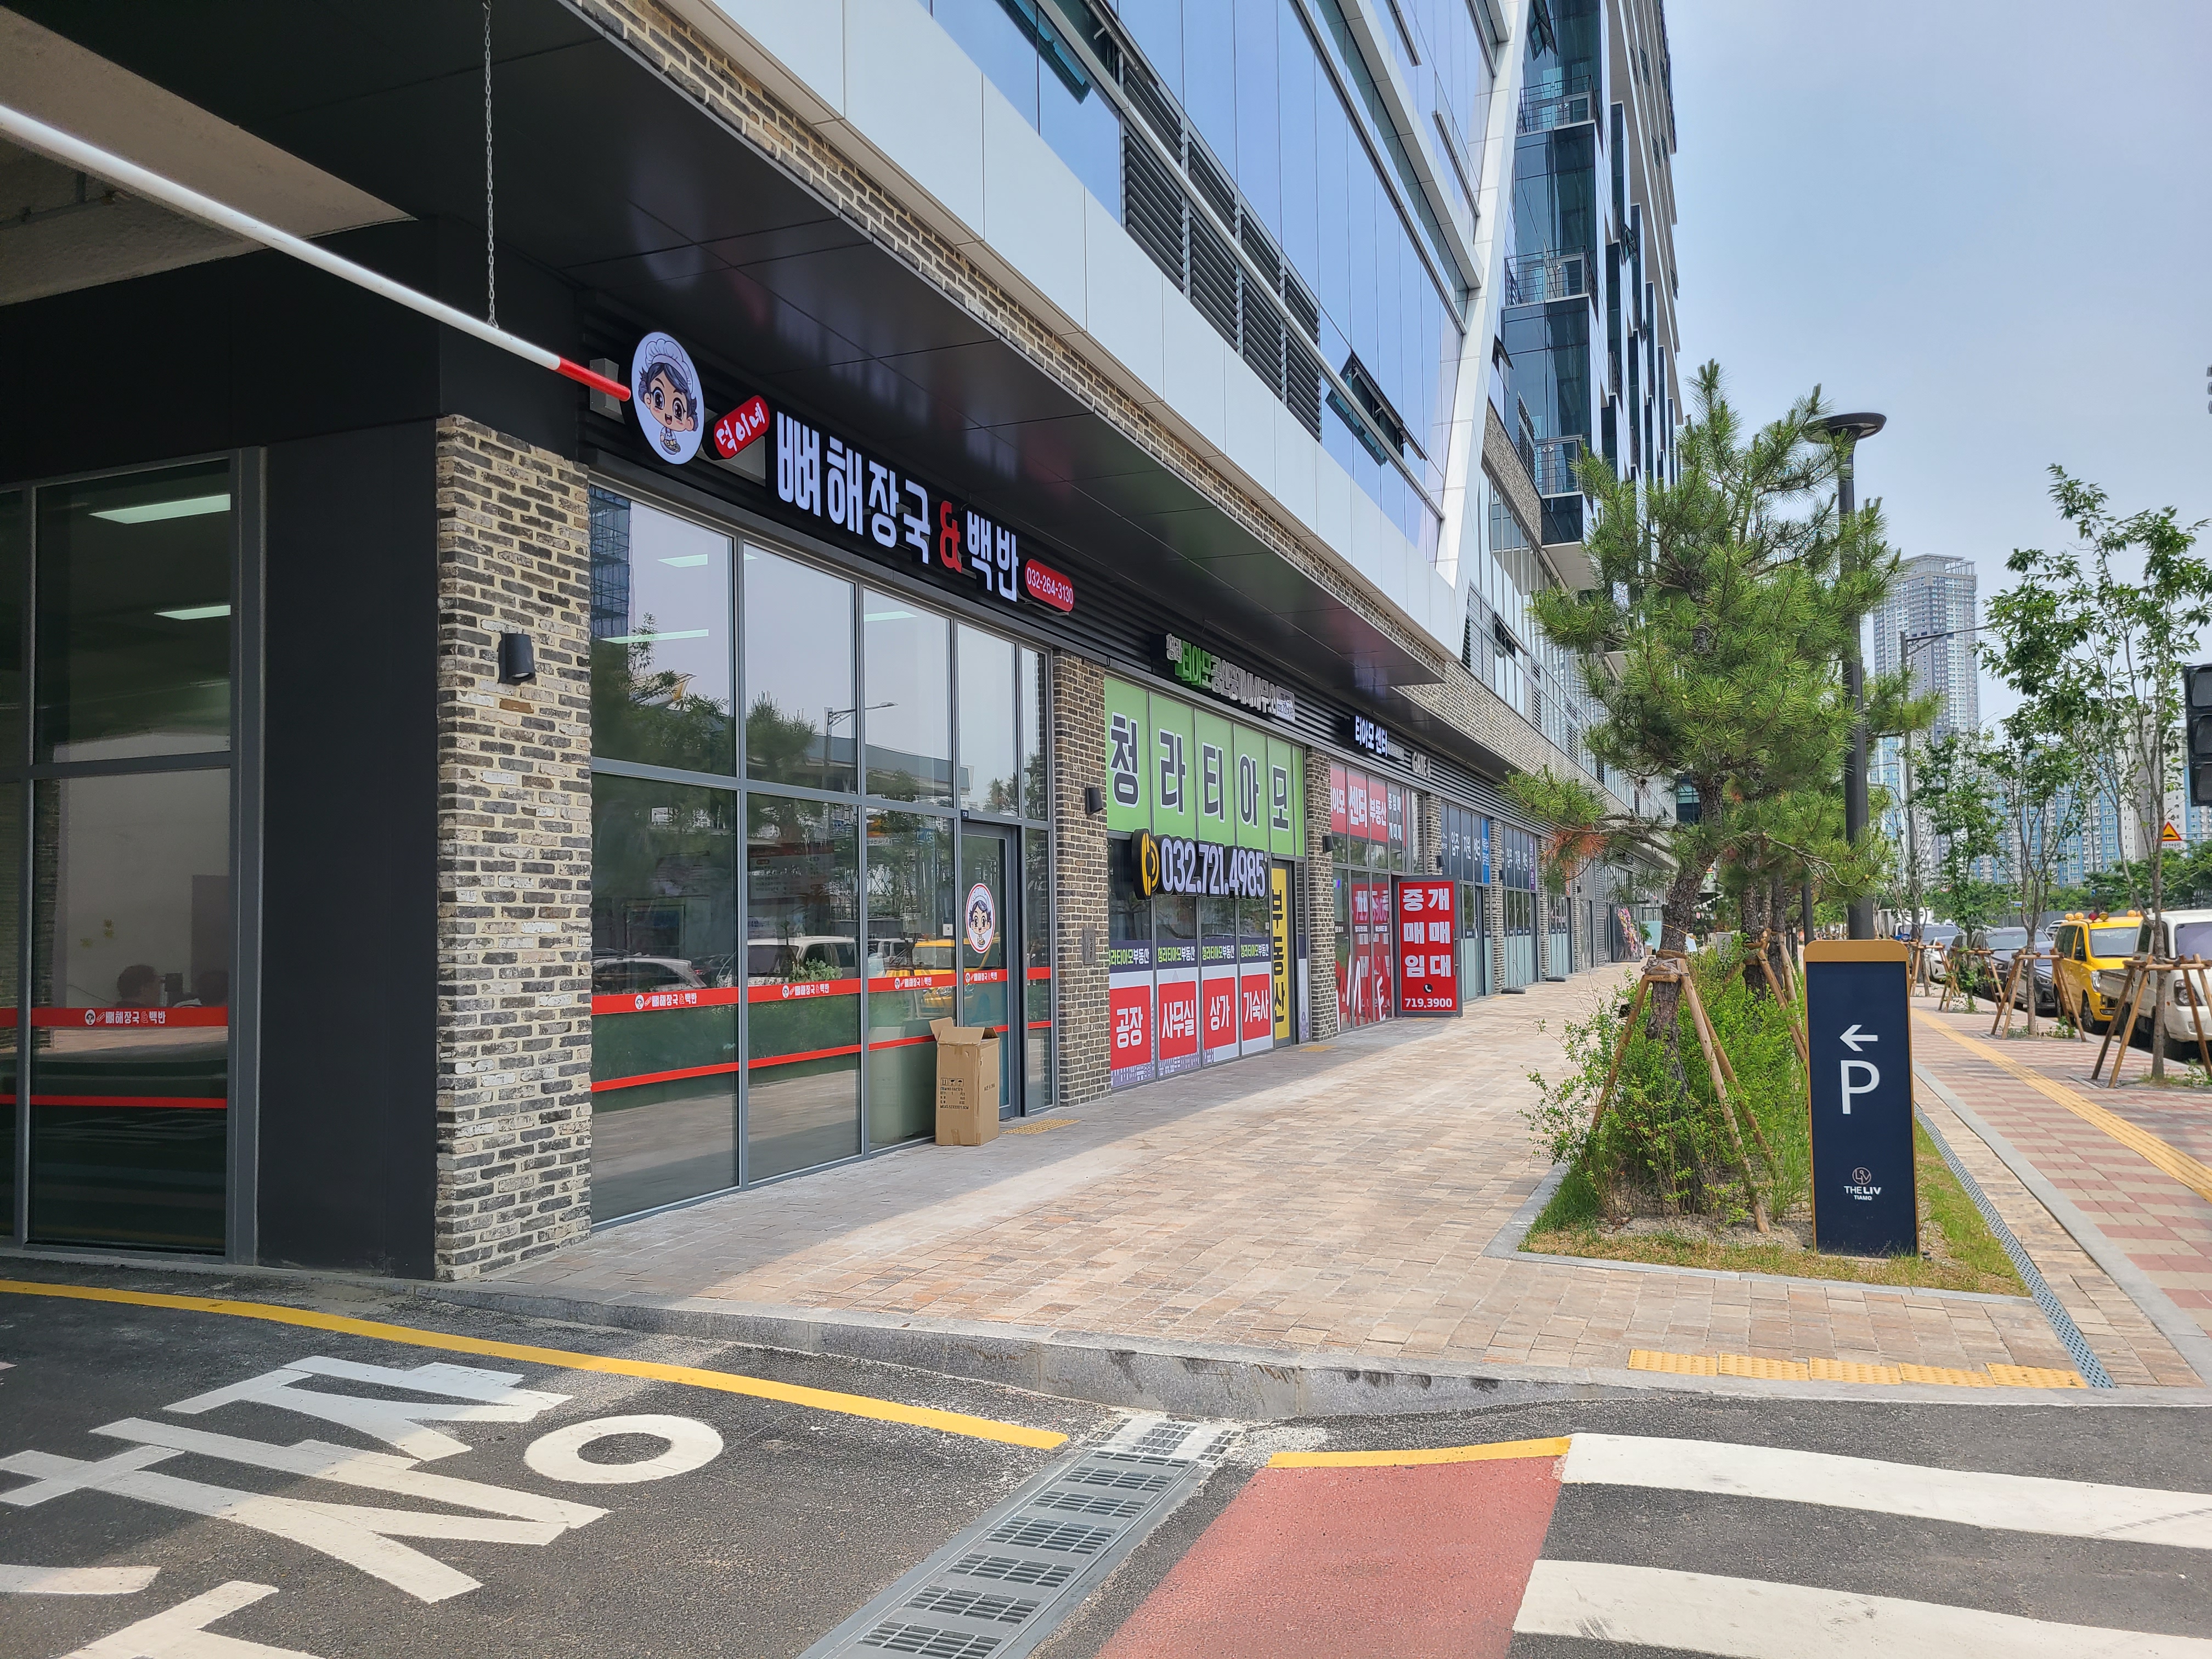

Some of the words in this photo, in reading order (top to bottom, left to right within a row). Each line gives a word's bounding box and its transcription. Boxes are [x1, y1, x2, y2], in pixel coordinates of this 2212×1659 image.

[777, 411, 930, 564] 뼈해장국
[940, 500, 962, 572] &
[967, 510, 1019, 602] 백반
[1027, 567, 1073, 605] 032-264-3130
[1356, 715, 1374, 749] 티아모
[1375, 725, 1387, 757] 센터
[1109, 711, 1289, 832] 청라티아모
[1412, 752, 1427, 776] GATE
[1349, 785, 1368, 828] 센터
[1370, 797, 1386, 827] 부동산
[1161, 838, 1266, 899] 032.721.4985
[1403, 888, 1450, 911] 중개
[1403, 922, 1451, 944] 매매
[1405, 955, 1452, 978] 임대
[1161, 1000, 1194, 1039] 사무실
[1210, 995, 1231, 1031] 상가
[1243, 989, 1268, 1023] 기숙사
[1405, 998, 1452, 1008] 719.3900
[1116, 1006, 1143, 1048] 공장
[1840, 1060, 1880, 1114] P
[1843, 1186, 1862, 1194] THE
[1863, 1186, 1881, 1195] LIV
